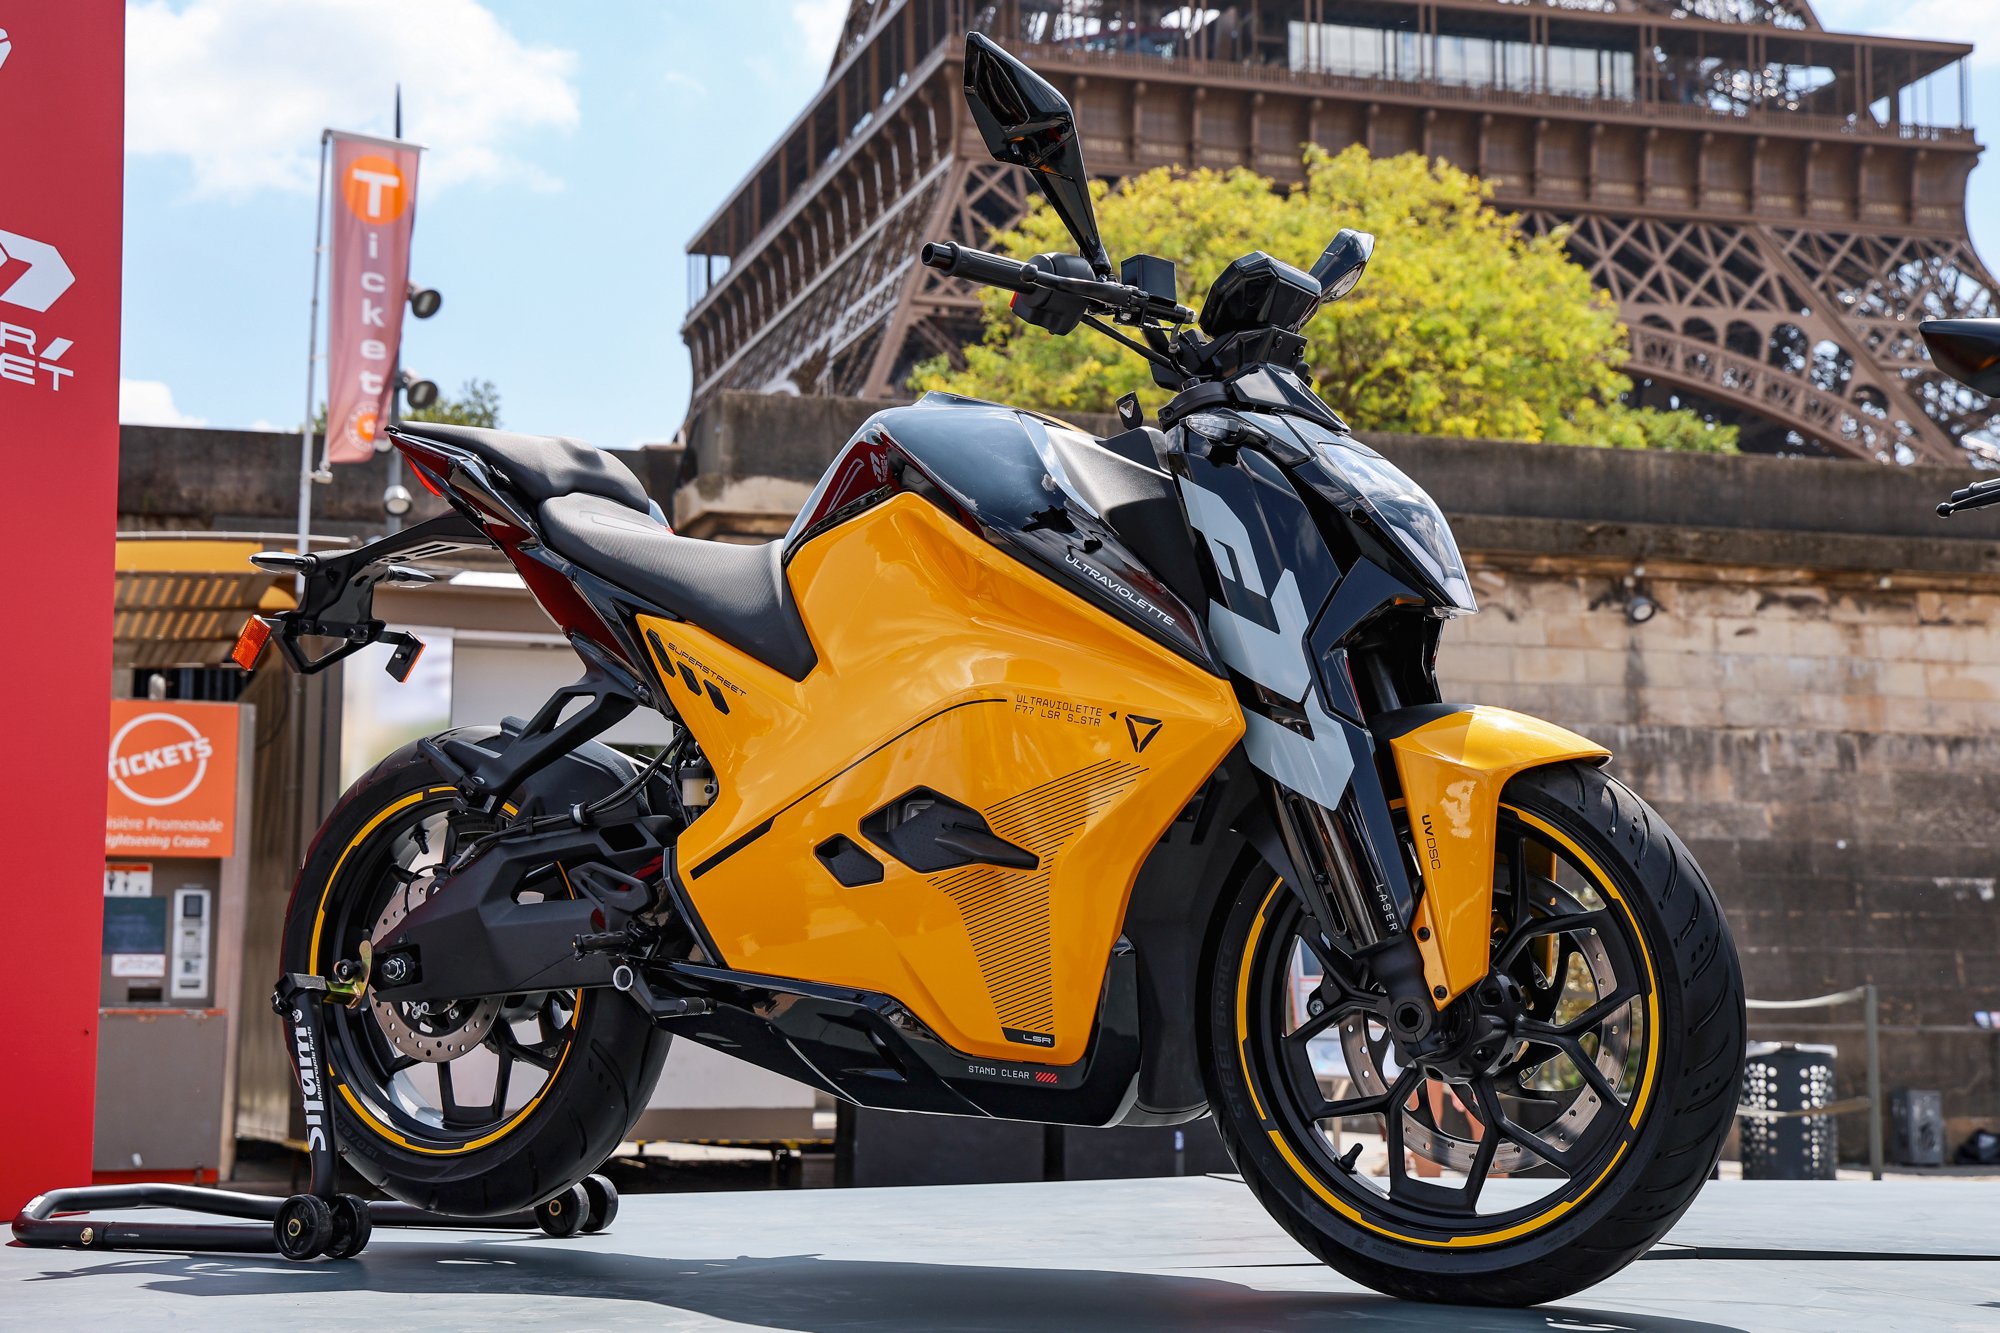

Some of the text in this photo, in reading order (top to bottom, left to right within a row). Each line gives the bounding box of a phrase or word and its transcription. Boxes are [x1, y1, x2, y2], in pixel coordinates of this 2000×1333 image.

[352, 167, 400, 395] Ticket
[1065, 553, 1176, 626] ULTRAVIOLETTE
[667, 642, 747, 697] SUPERSTREET
[1014, 704, 1101, 727] F77 LSR S_STR
[1016, 694, 1103, 717] ULTRAVIOLETTE
[146, 815, 224, 833] Promenade
[172, 835, 211, 848] Cruise
[1375, 883, 1399, 932] LASER
[306, 1026, 315, 1051] Parts
[1022, 1033, 1053, 1045] LSR
[968, 1065, 1030, 1080] STAND CLEAR
